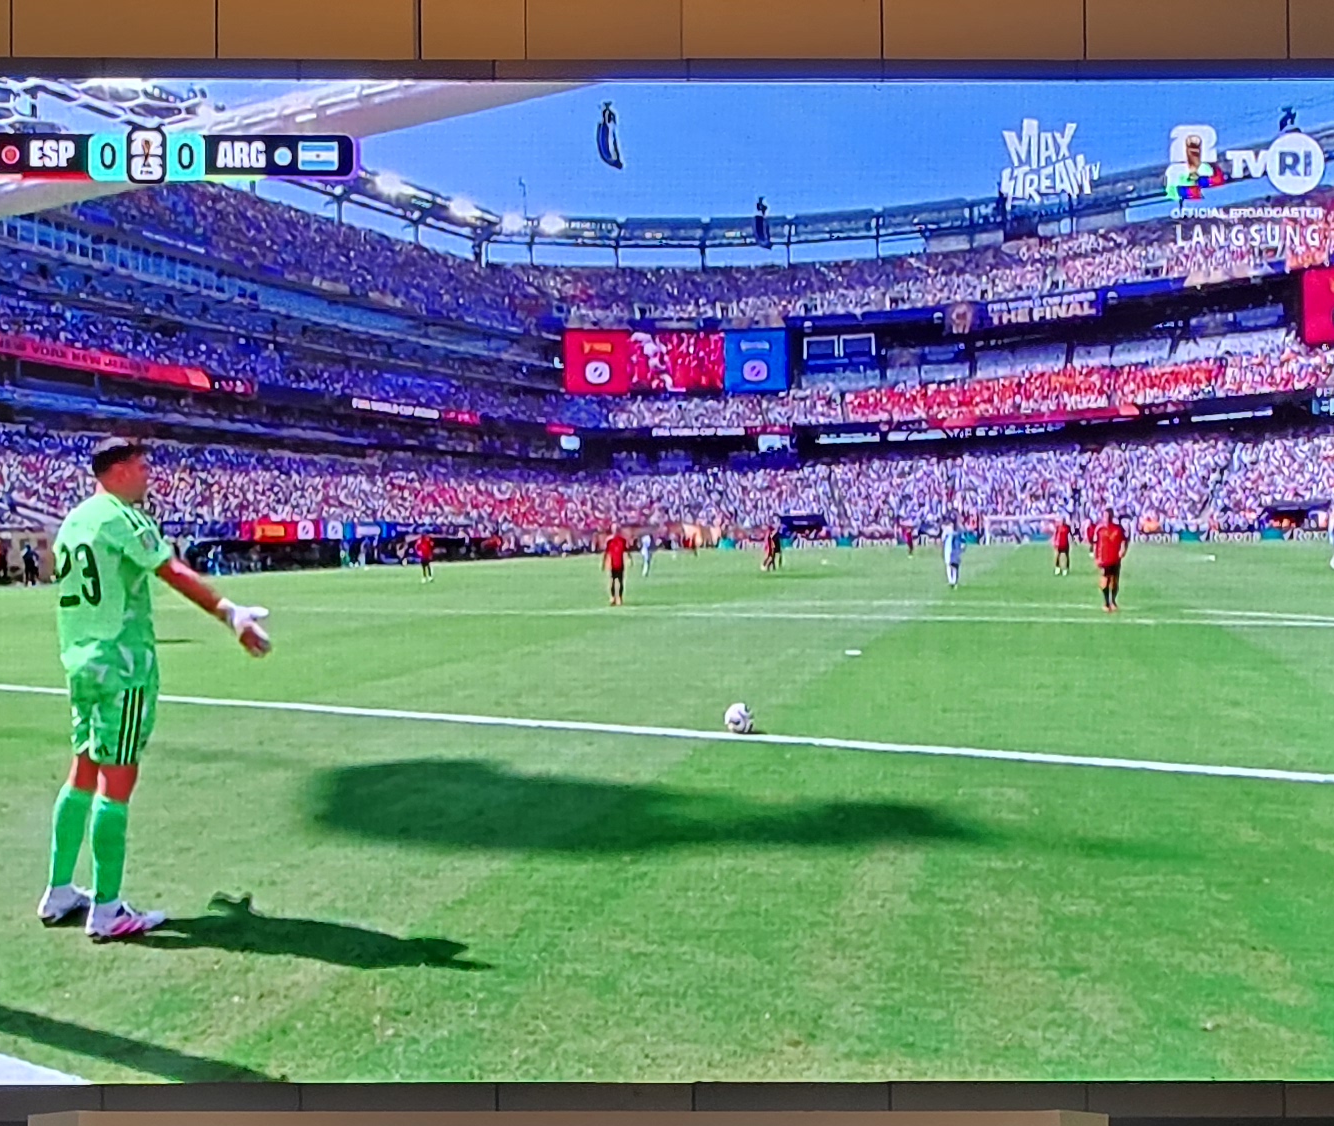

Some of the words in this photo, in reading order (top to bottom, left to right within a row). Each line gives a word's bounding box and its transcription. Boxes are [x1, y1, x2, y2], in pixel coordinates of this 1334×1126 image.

[29, 139, 75, 168] ESP
[100, 142, 116, 170] 0
[178, 142, 194, 170] 0
[216, 140, 266, 169] ARG
[1002, 118, 1077, 168] MAX
[1001, 154, 1091, 211] STREAM
[1171, 207, 1228, 219] OFFICIAL
[1175, 224, 1320, 249] LANGSUNG
[989, 310, 1030, 326] THE
[1033, 301, 1096, 323] FINAL
[54, 543, 101, 606] 23
